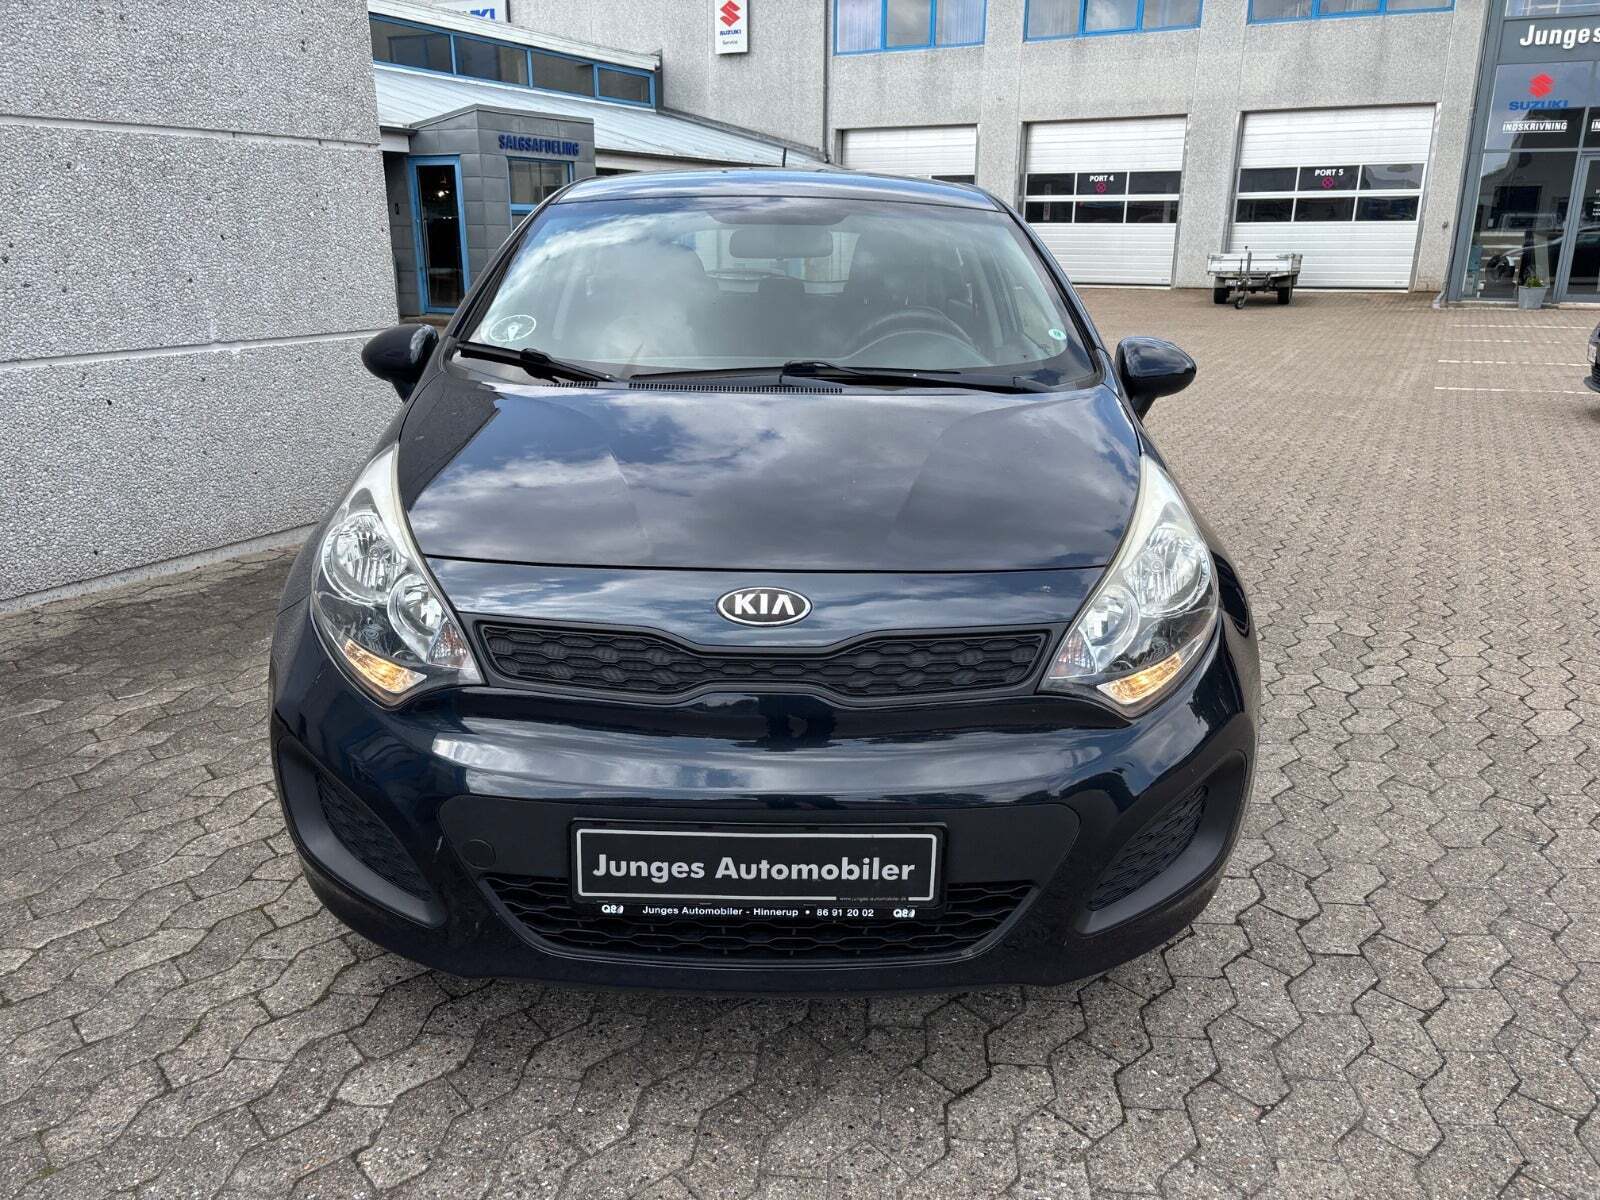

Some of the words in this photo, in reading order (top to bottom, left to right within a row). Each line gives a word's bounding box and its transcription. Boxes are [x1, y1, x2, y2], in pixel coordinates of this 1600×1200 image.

[1520, 25, 1600, 49] Junges
[1509, 100, 1568, 111] SUZUKI
[1502, 121, 1568, 132] INDSKRIVNING
[1109, 174, 1114, 182] 4
[1314, 168, 1336, 177] PORT
[1338, 168, 1344, 176] 5
[734, 593, 796, 616] KIA
[592, 854, 706, 883] Junges
[714, 857, 916, 881] Automobiler
[642, 905, 679, 915] Junges
[681, 906, 743, 916] Automobiler
[753, 908, 799, 918] Hinnerup
[816, 908, 829, 918] 86
[831, 909, 843, 917] 91
[846, 909, 859, 918] 20
[861, 909, 874, 917] 02
